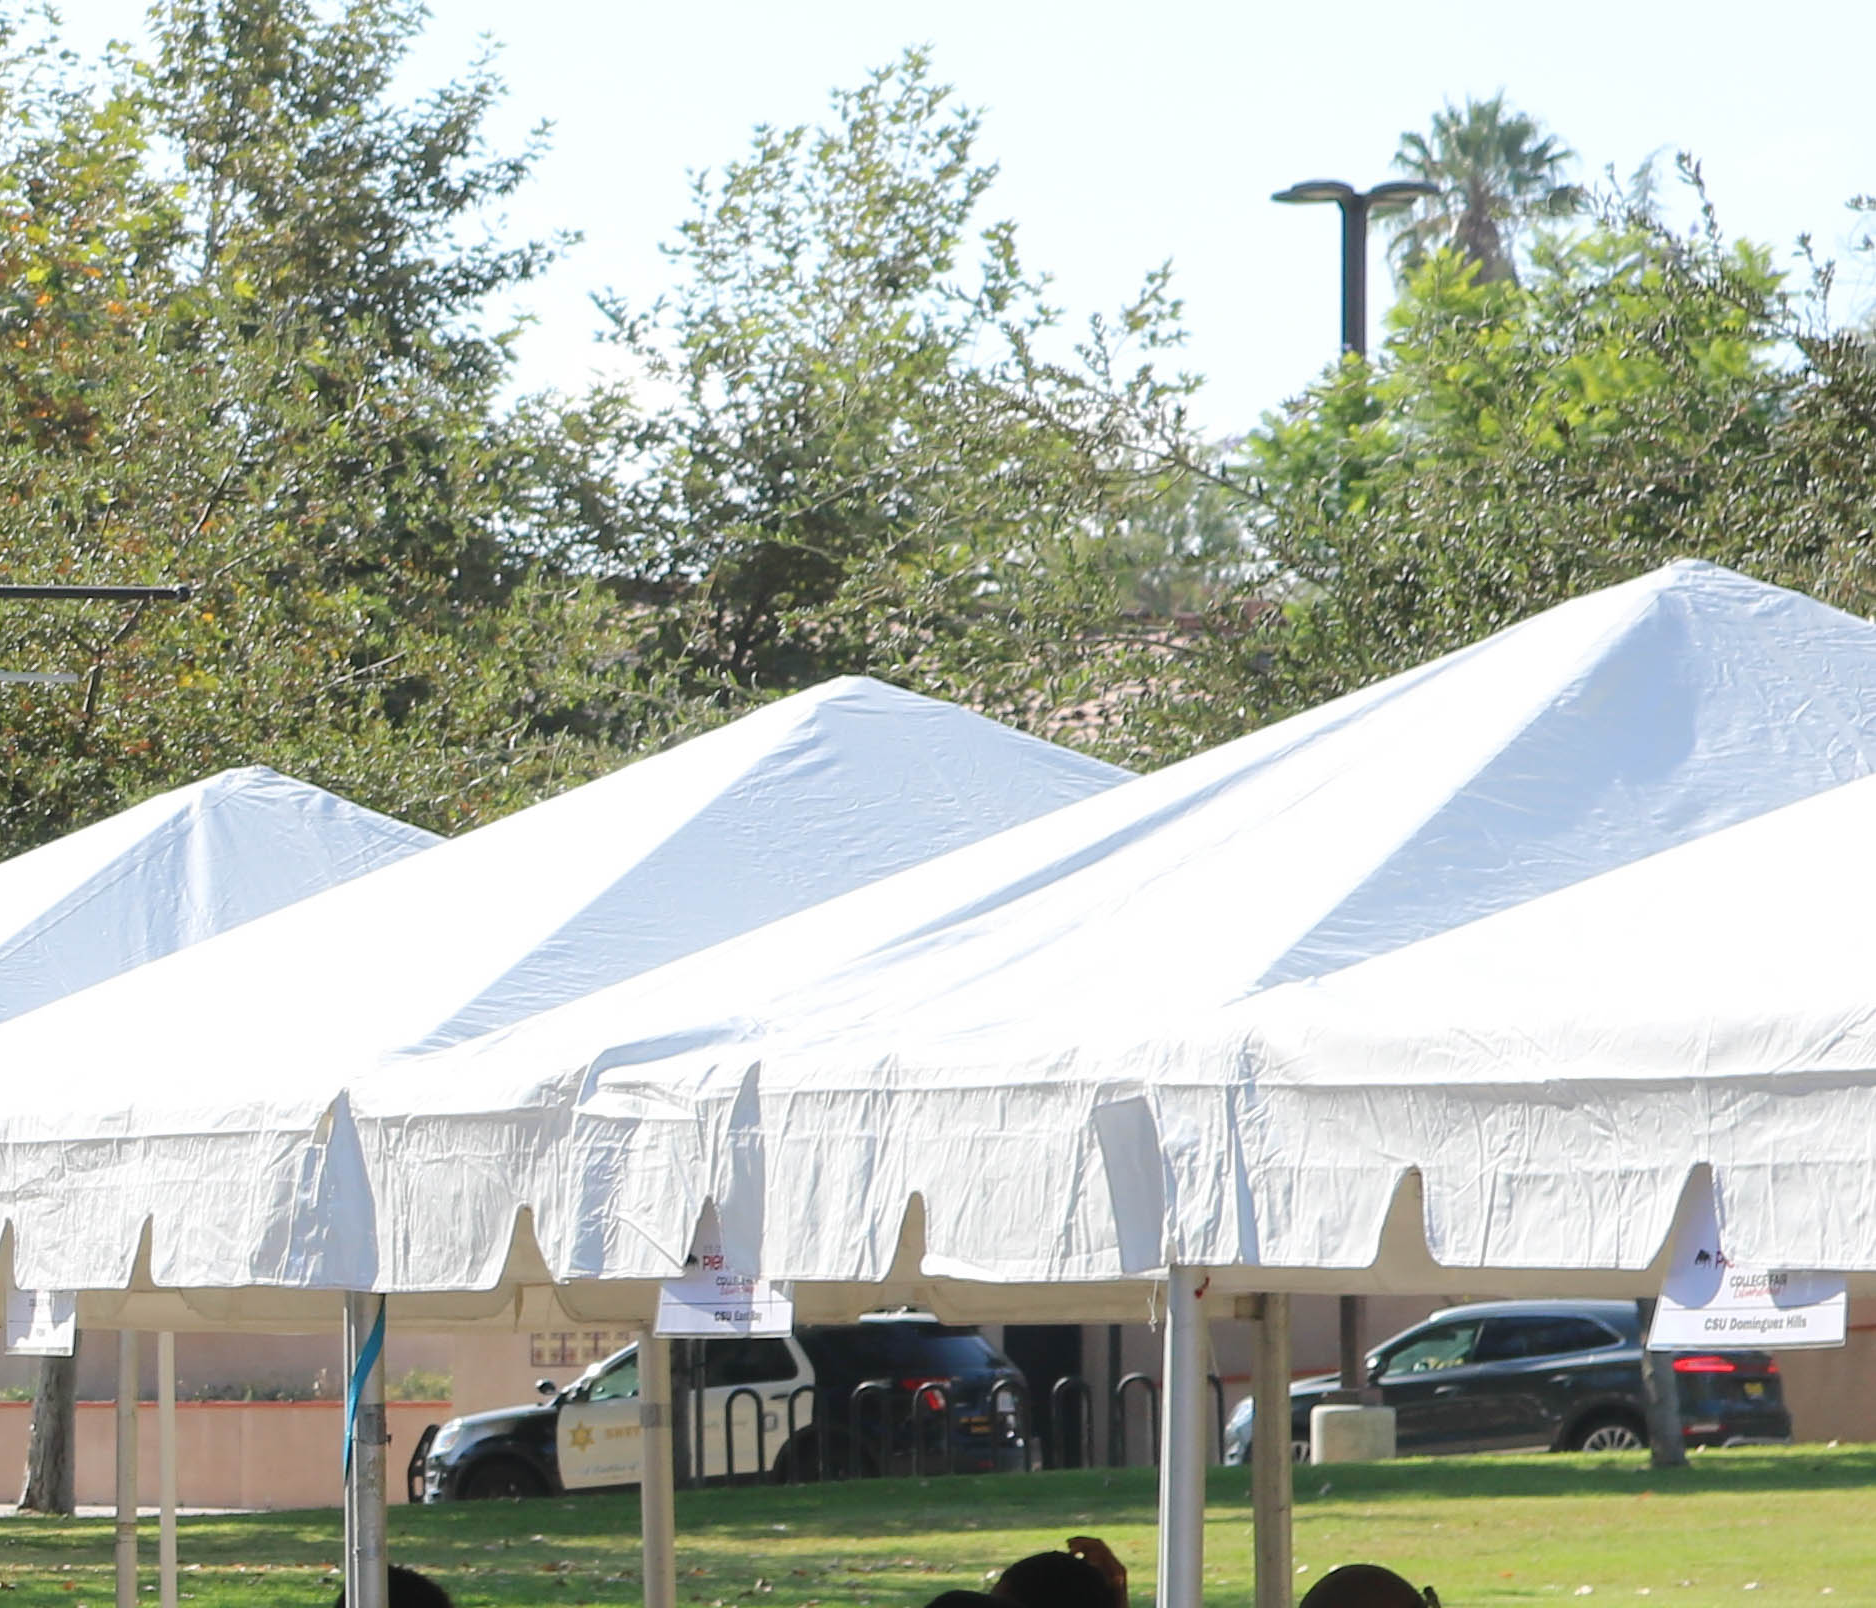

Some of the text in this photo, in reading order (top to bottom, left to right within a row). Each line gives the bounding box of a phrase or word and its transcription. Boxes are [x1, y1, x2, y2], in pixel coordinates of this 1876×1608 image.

[1729, 1273, 1788, 1289] COLLEGE FAIR
[1704, 1315, 1807, 1334] CSU Dominguez Hills
